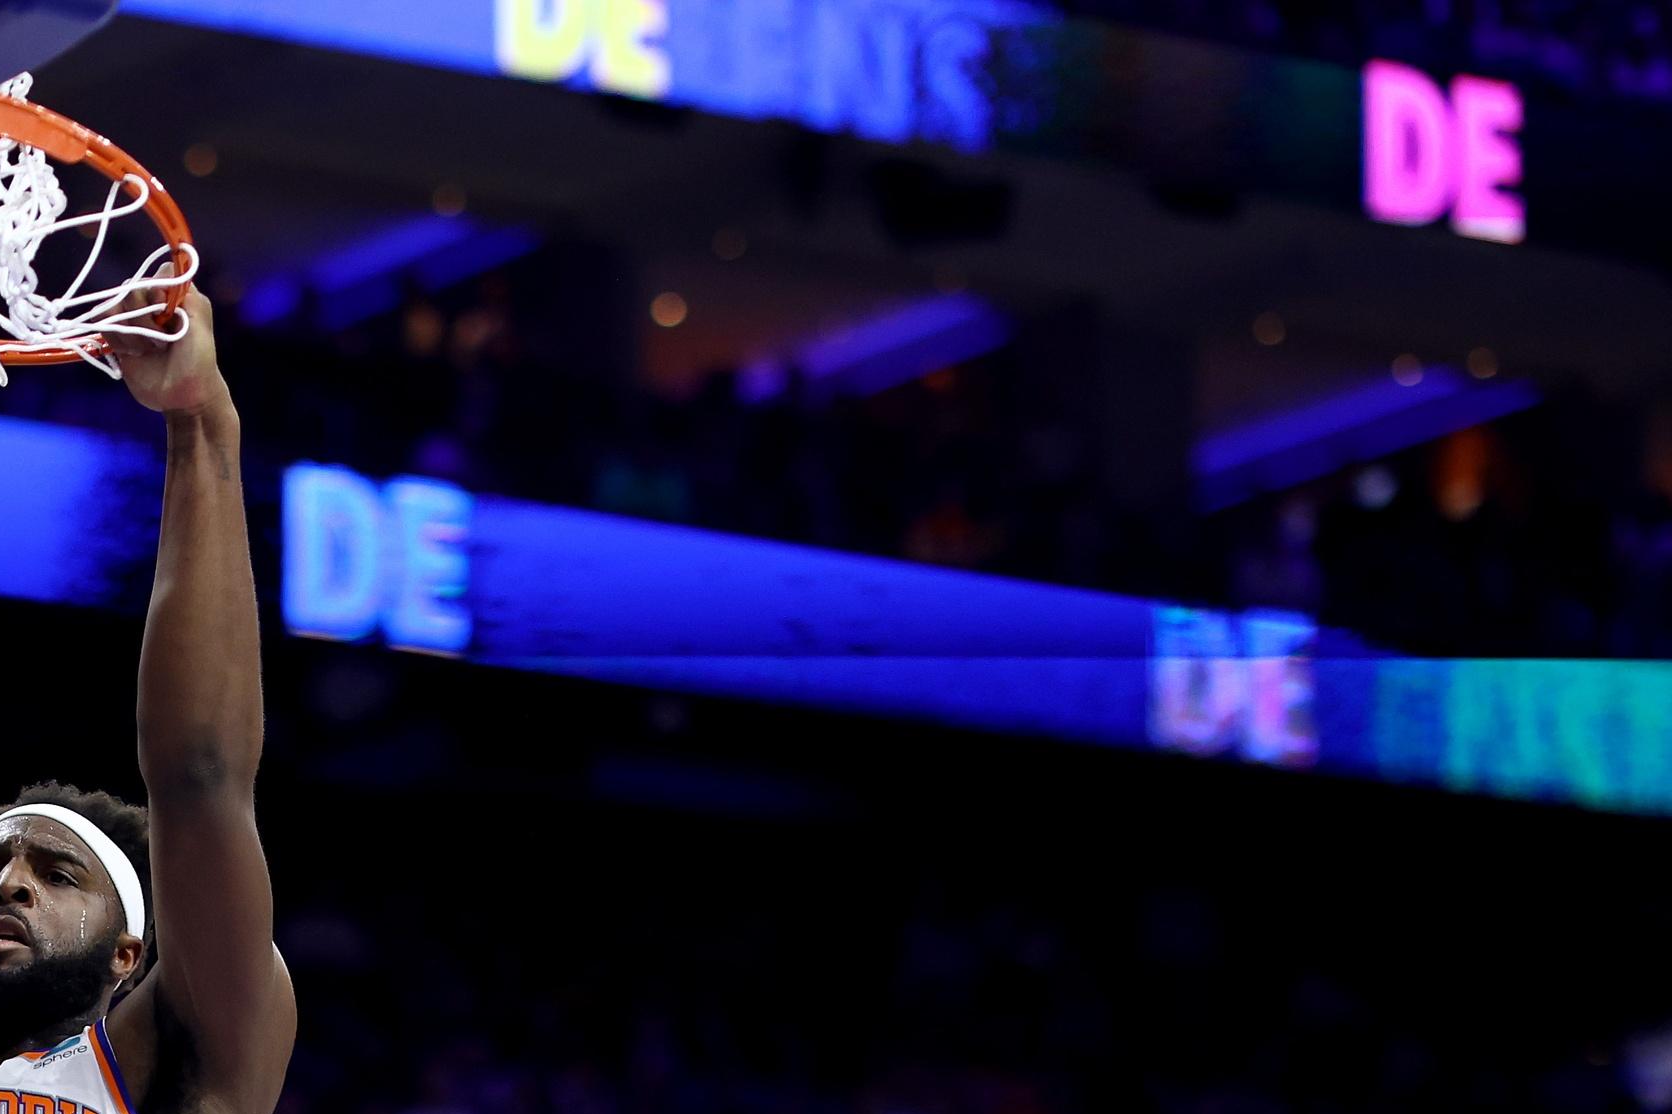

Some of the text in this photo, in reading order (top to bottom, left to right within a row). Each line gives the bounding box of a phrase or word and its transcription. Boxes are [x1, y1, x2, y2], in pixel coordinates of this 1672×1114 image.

[1362, 58, 1525, 244] DE
[281, 460, 474, 657] DE
[33, 1045, 88, 1069] sphere
